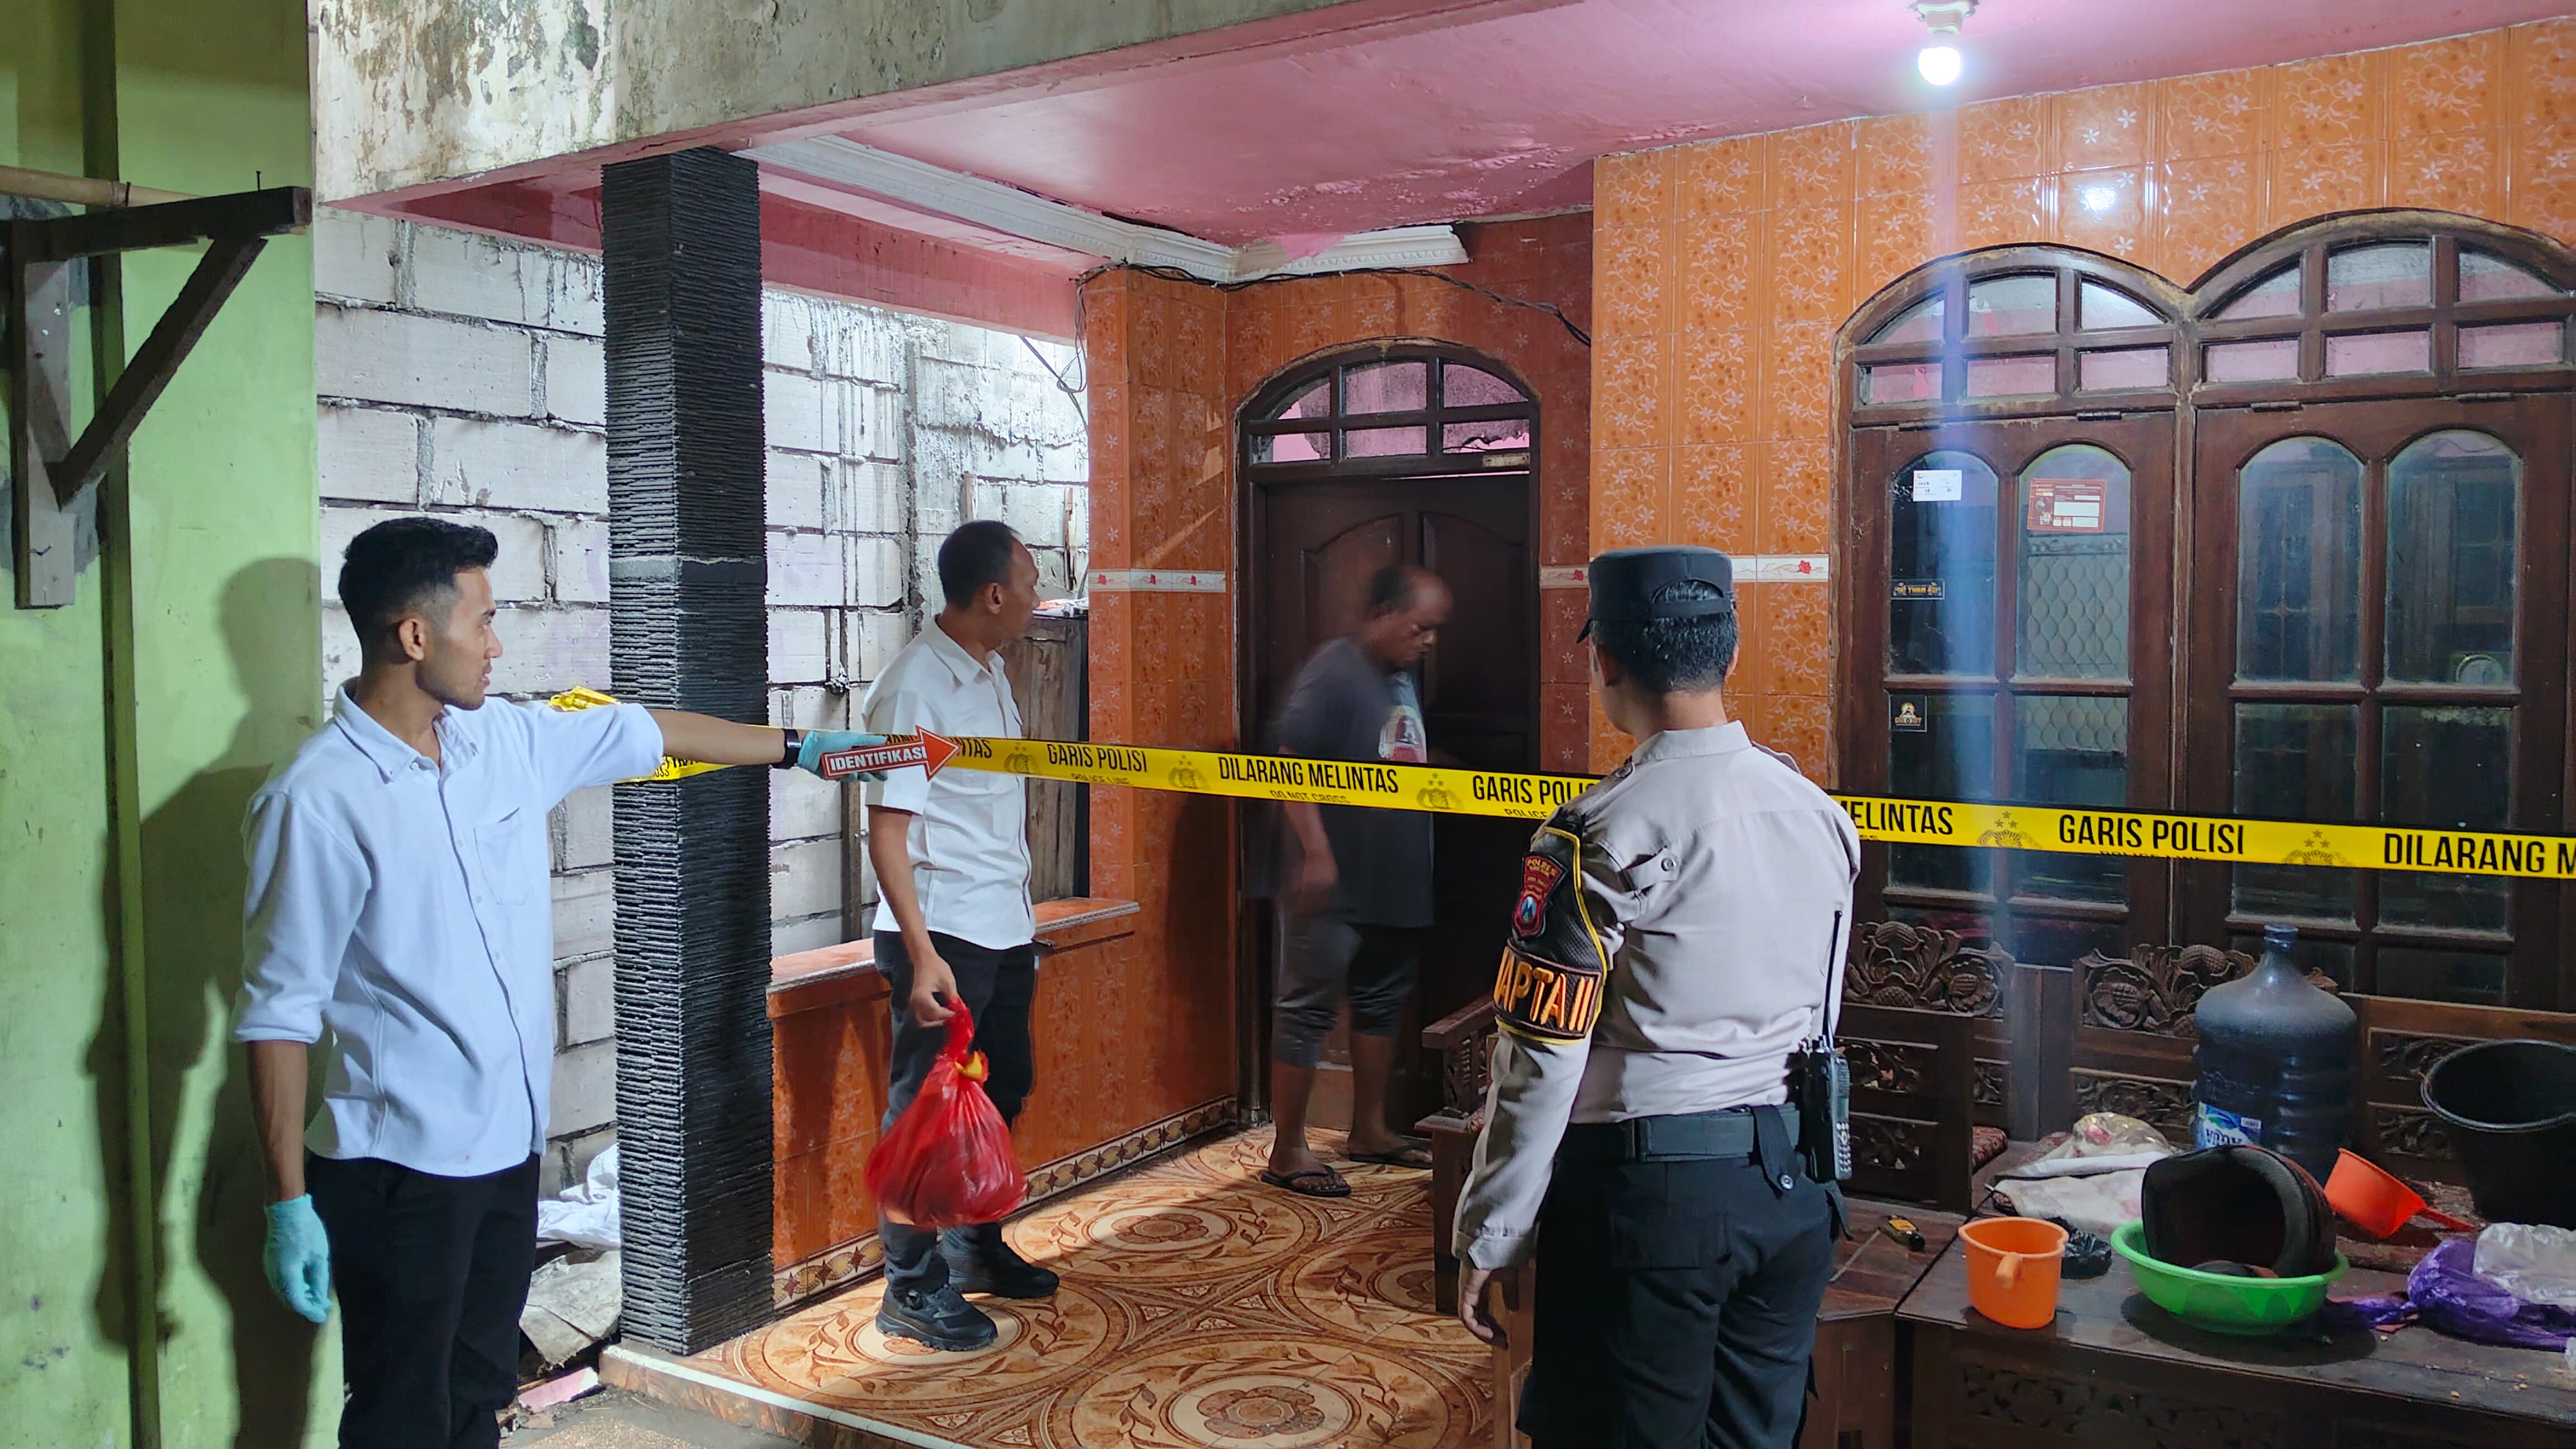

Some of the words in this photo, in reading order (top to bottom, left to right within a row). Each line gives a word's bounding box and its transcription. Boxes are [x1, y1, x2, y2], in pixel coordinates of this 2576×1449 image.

[830, 746, 928, 771] IDENTIFIKASI
[1046, 744, 1094, 768] GARIS
[1095, 747, 1147, 773] POLISI
[1217, 757, 1303, 785] DILARANG
[1308, 763, 1399, 793] MELINTAS
[1473, 775, 1533, 804] GARIS
[1538, 779, 1596, 806] POLI
[1311, 793, 1351, 804] CROSS
[2059, 814, 2143, 848] GARIS
[2152, 819, 2244, 855] POLISI
[2384, 833, 2546, 873] DILARANG
